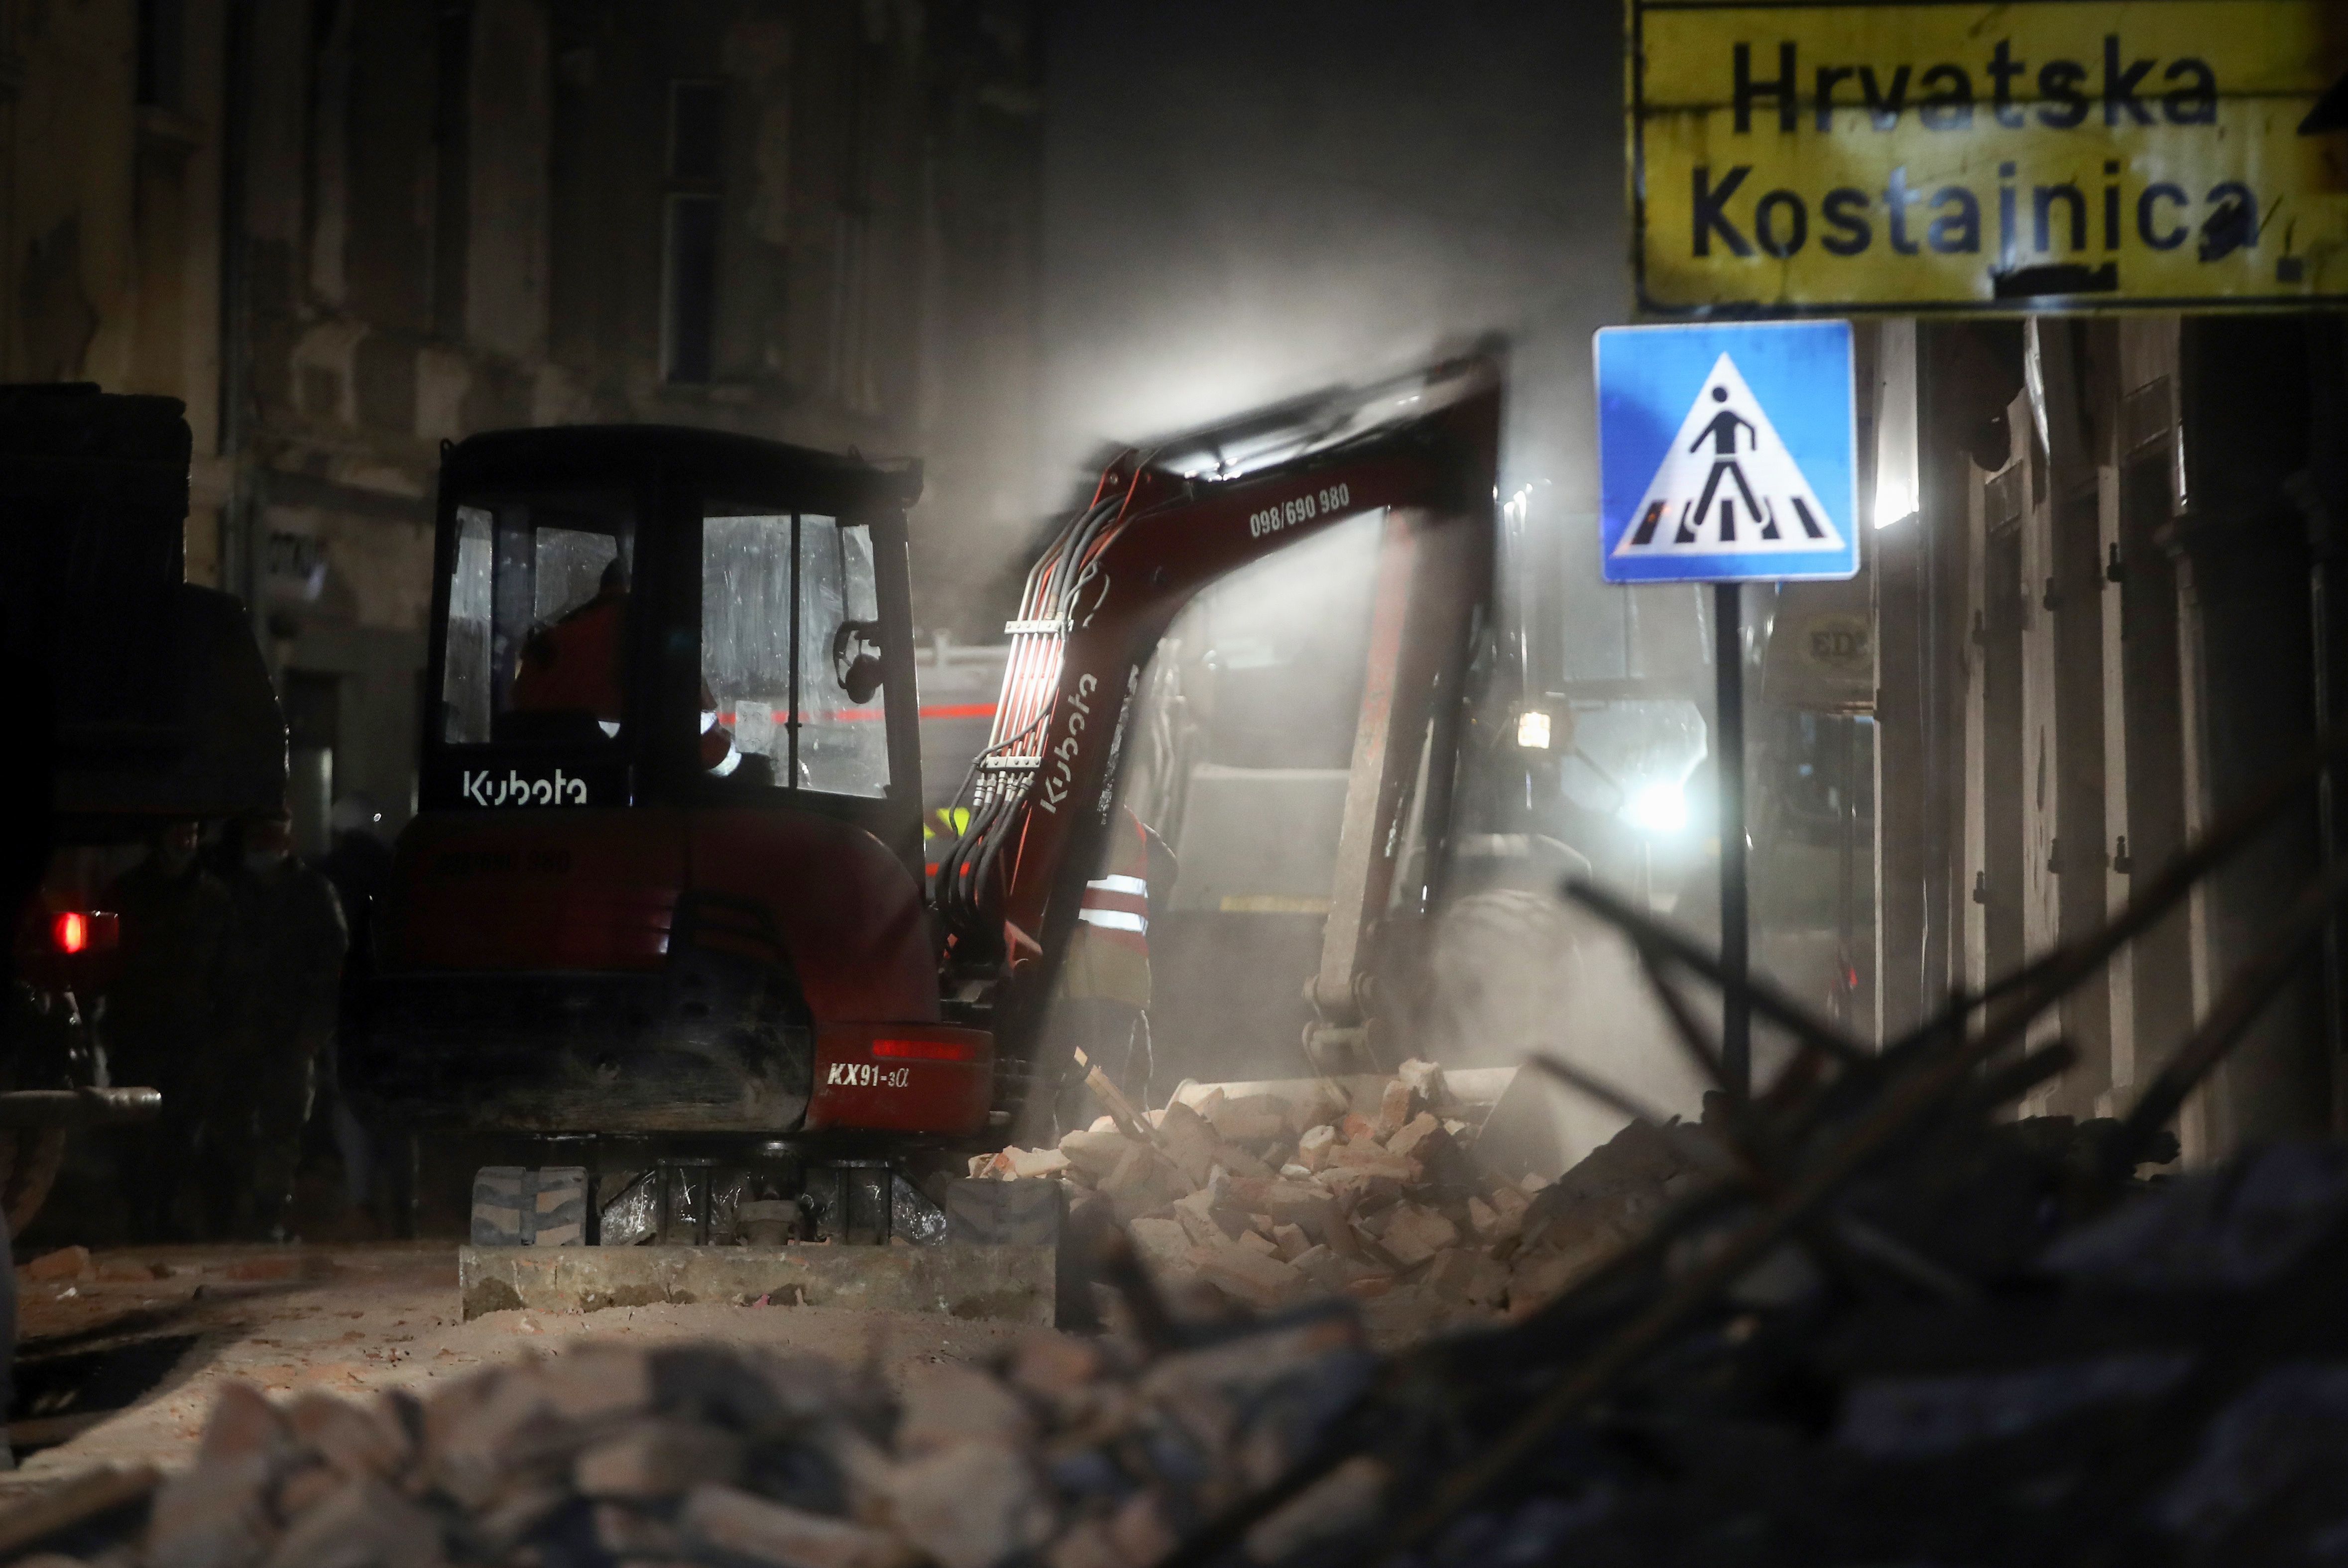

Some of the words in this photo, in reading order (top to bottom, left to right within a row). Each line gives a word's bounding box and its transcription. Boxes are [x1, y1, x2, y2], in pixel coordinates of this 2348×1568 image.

[1732, 35, 2218, 133] Hrvatska
[1691, 159, 2259, 275] Kostajnica
[1250, 494, 1316, 538] 098/690
[1320, 483, 1350, 514] 980
[464, 769, 587, 806] Kubota
[1040, 673, 1098, 814] Kubota
